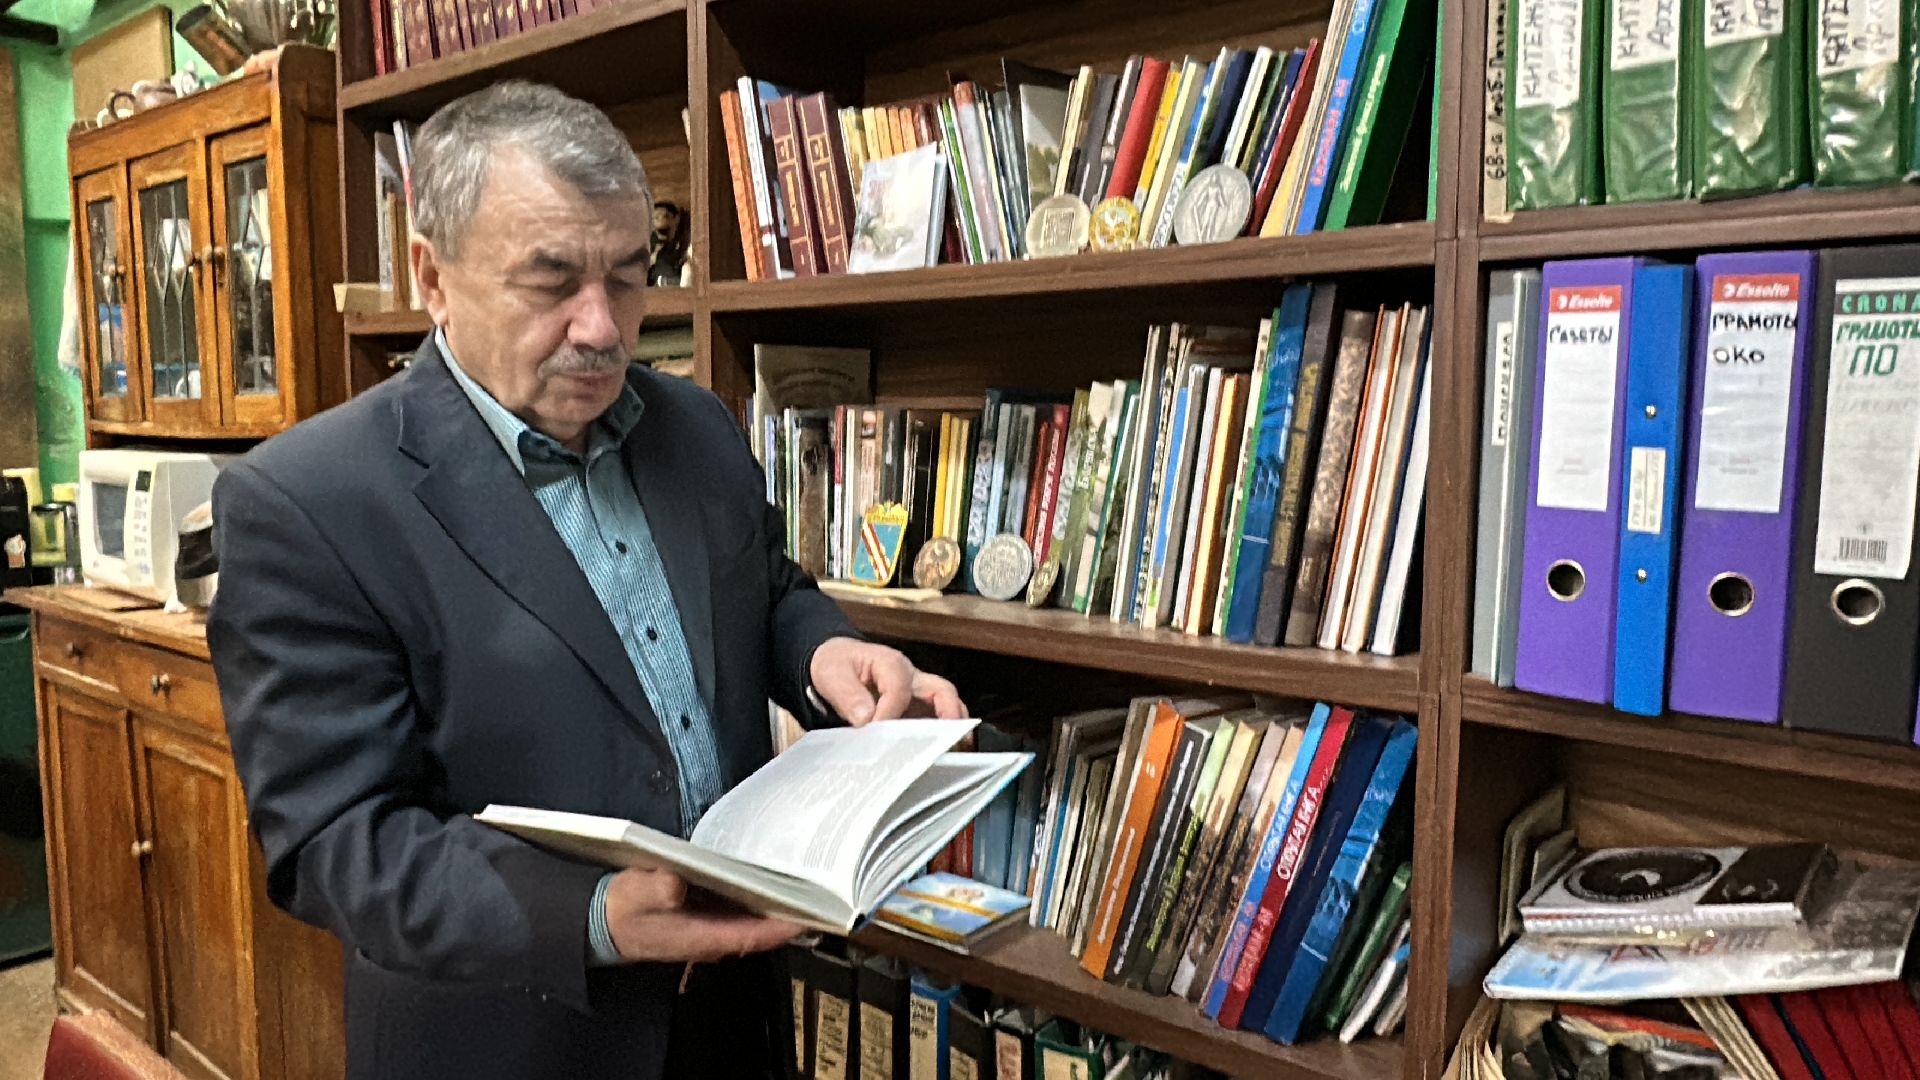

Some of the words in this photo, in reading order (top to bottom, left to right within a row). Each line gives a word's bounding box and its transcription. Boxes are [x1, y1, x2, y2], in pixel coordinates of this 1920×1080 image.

[1523, 0, 1542, 98] КИТЕЖ
[1617, 0, 1640, 61] КИТ
[1712, 312, 1799, 332] ГРАМОТЫ
[1848, 344, 1900, 376] ПО
